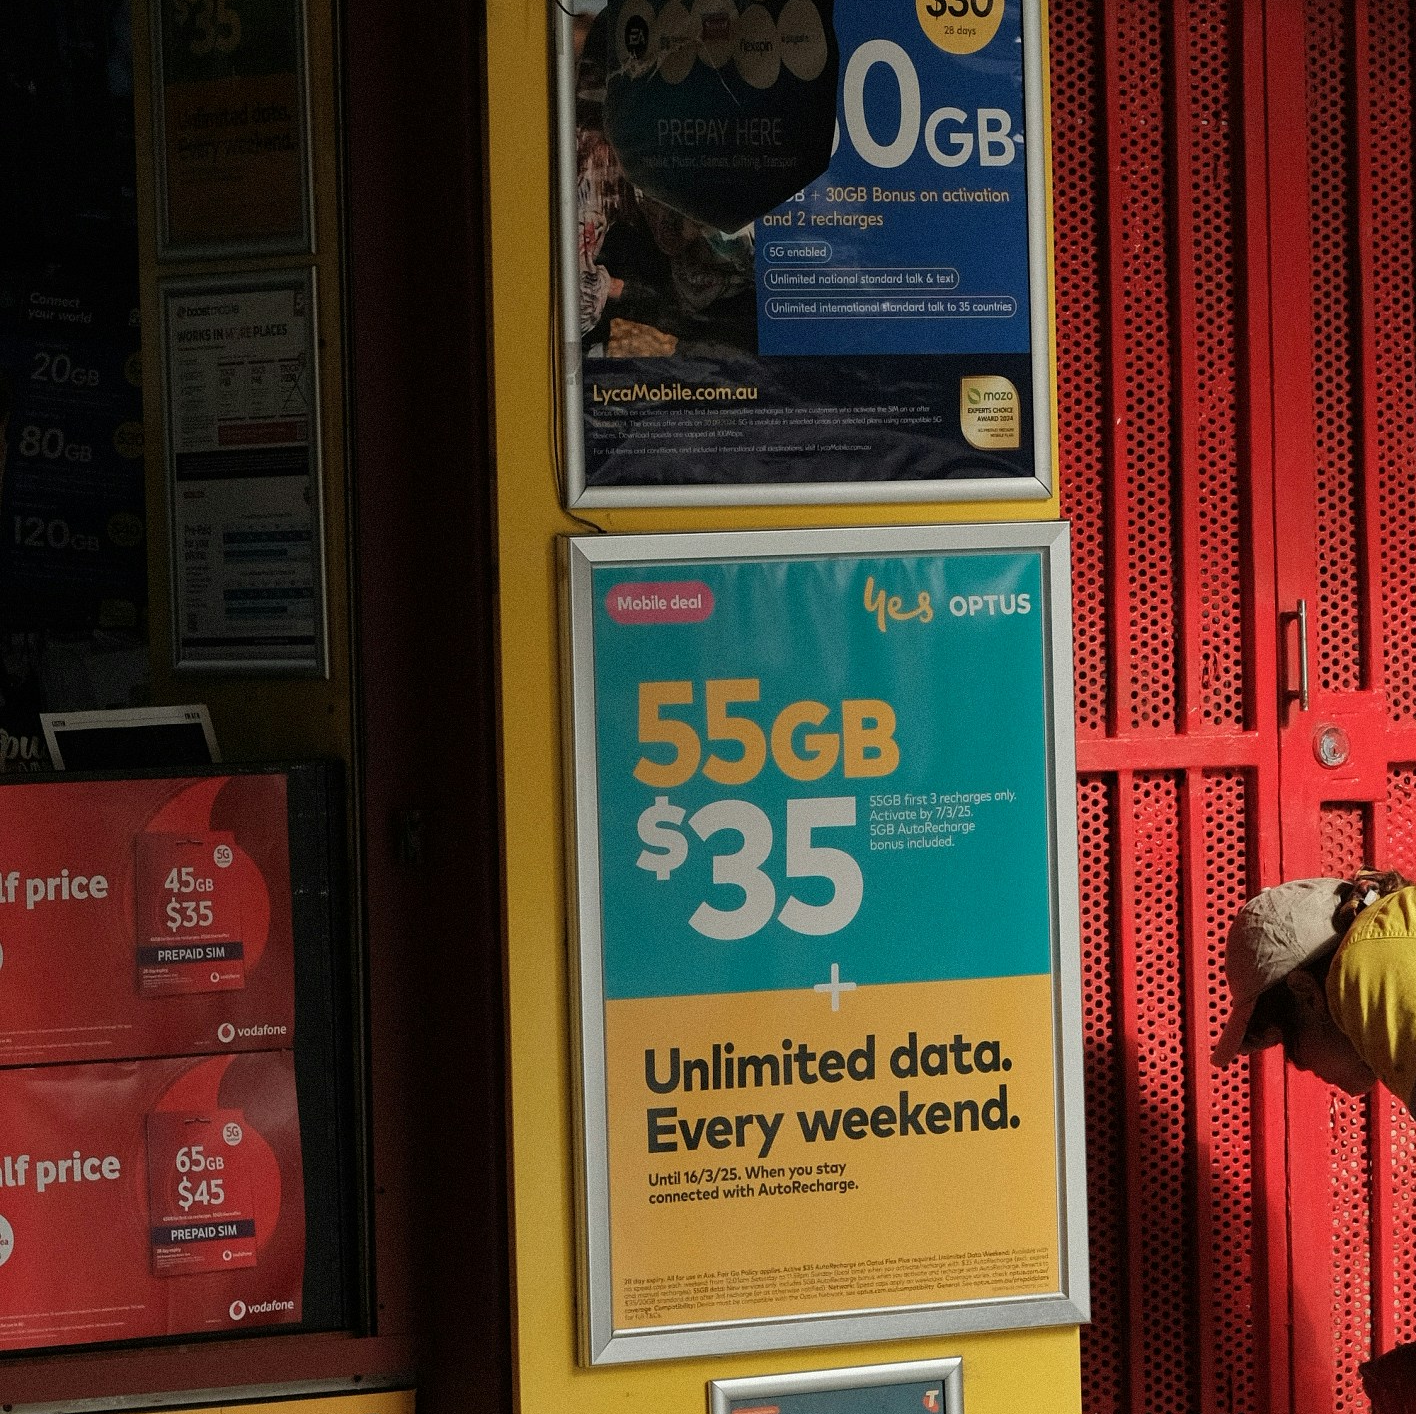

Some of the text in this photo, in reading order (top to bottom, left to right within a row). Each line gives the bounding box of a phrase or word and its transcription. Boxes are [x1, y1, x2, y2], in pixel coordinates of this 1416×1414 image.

[944, 24, 977, 37] 28 days
[829, 39, 1016, 169] 0GB
[656, 116, 784, 147] PREPAY HERE
[825, 187, 868, 203] 30GB
[872, 187, 916, 203] Bonus
[919, 191, 939, 203] on
[942, 186, 1010, 203] activation
[763, 210, 884, 230] and 2 recharges
[769, 246, 827, 258] 5G enabled
[769, 272, 955, 285] Unlimited national standard talk & text
[770, 301, 1013, 314] Unlimited international standard talk to 35 countries
[30, 351, 101, 388] 20GB
[593, 383, 758, 406] LycaMobile.com.au
[983, 391, 1013, 401] mozo
[17, 424, 93, 464] 80GB
[13, 515, 101, 553] 120GB
[617, 593, 702, 612] Mobile deal
[864, 576, 934, 633] yes
[949, 593, 1031, 617] OPTUS
[632, 677, 900, 789] 55GB
[869, 788, 1017, 808] 55GB first 3 recharges only.
[869, 805, 974, 822] Activate by 7/3/25.
[869, 820, 976, 837] 5GB AutoRecharge
[216, 847, 230, 860] 5G
[869, 834, 956, 851] bonus included.
[164, 866, 214, 893] 45GB
[635, 795, 865, 942] $35
[26, 868, 109, 910] price
[165, 897, 214, 933] $35
[157, 946, 226, 963] PREPAID SIM
[237, 1023, 287, 1038] vodafone
[644, 1031, 1013, 1095] Unlimited data.
[225, 1125, 240, 1139] 5G
[646, 1083, 1022, 1159] Every weekend.
[175, 1145, 225, 1173] 65GB
[36, 1150, 121, 1193] price
[648, 1161, 847, 1188] Until 16/3/25. When you stay
[177, 1176, 225, 1212] $45
[648, 1177, 860, 1206] connected with AutoRecharge.
[170, 1224, 238, 1242] PREPAID SIM
[248, 1299, 295, 1314] vodafone
